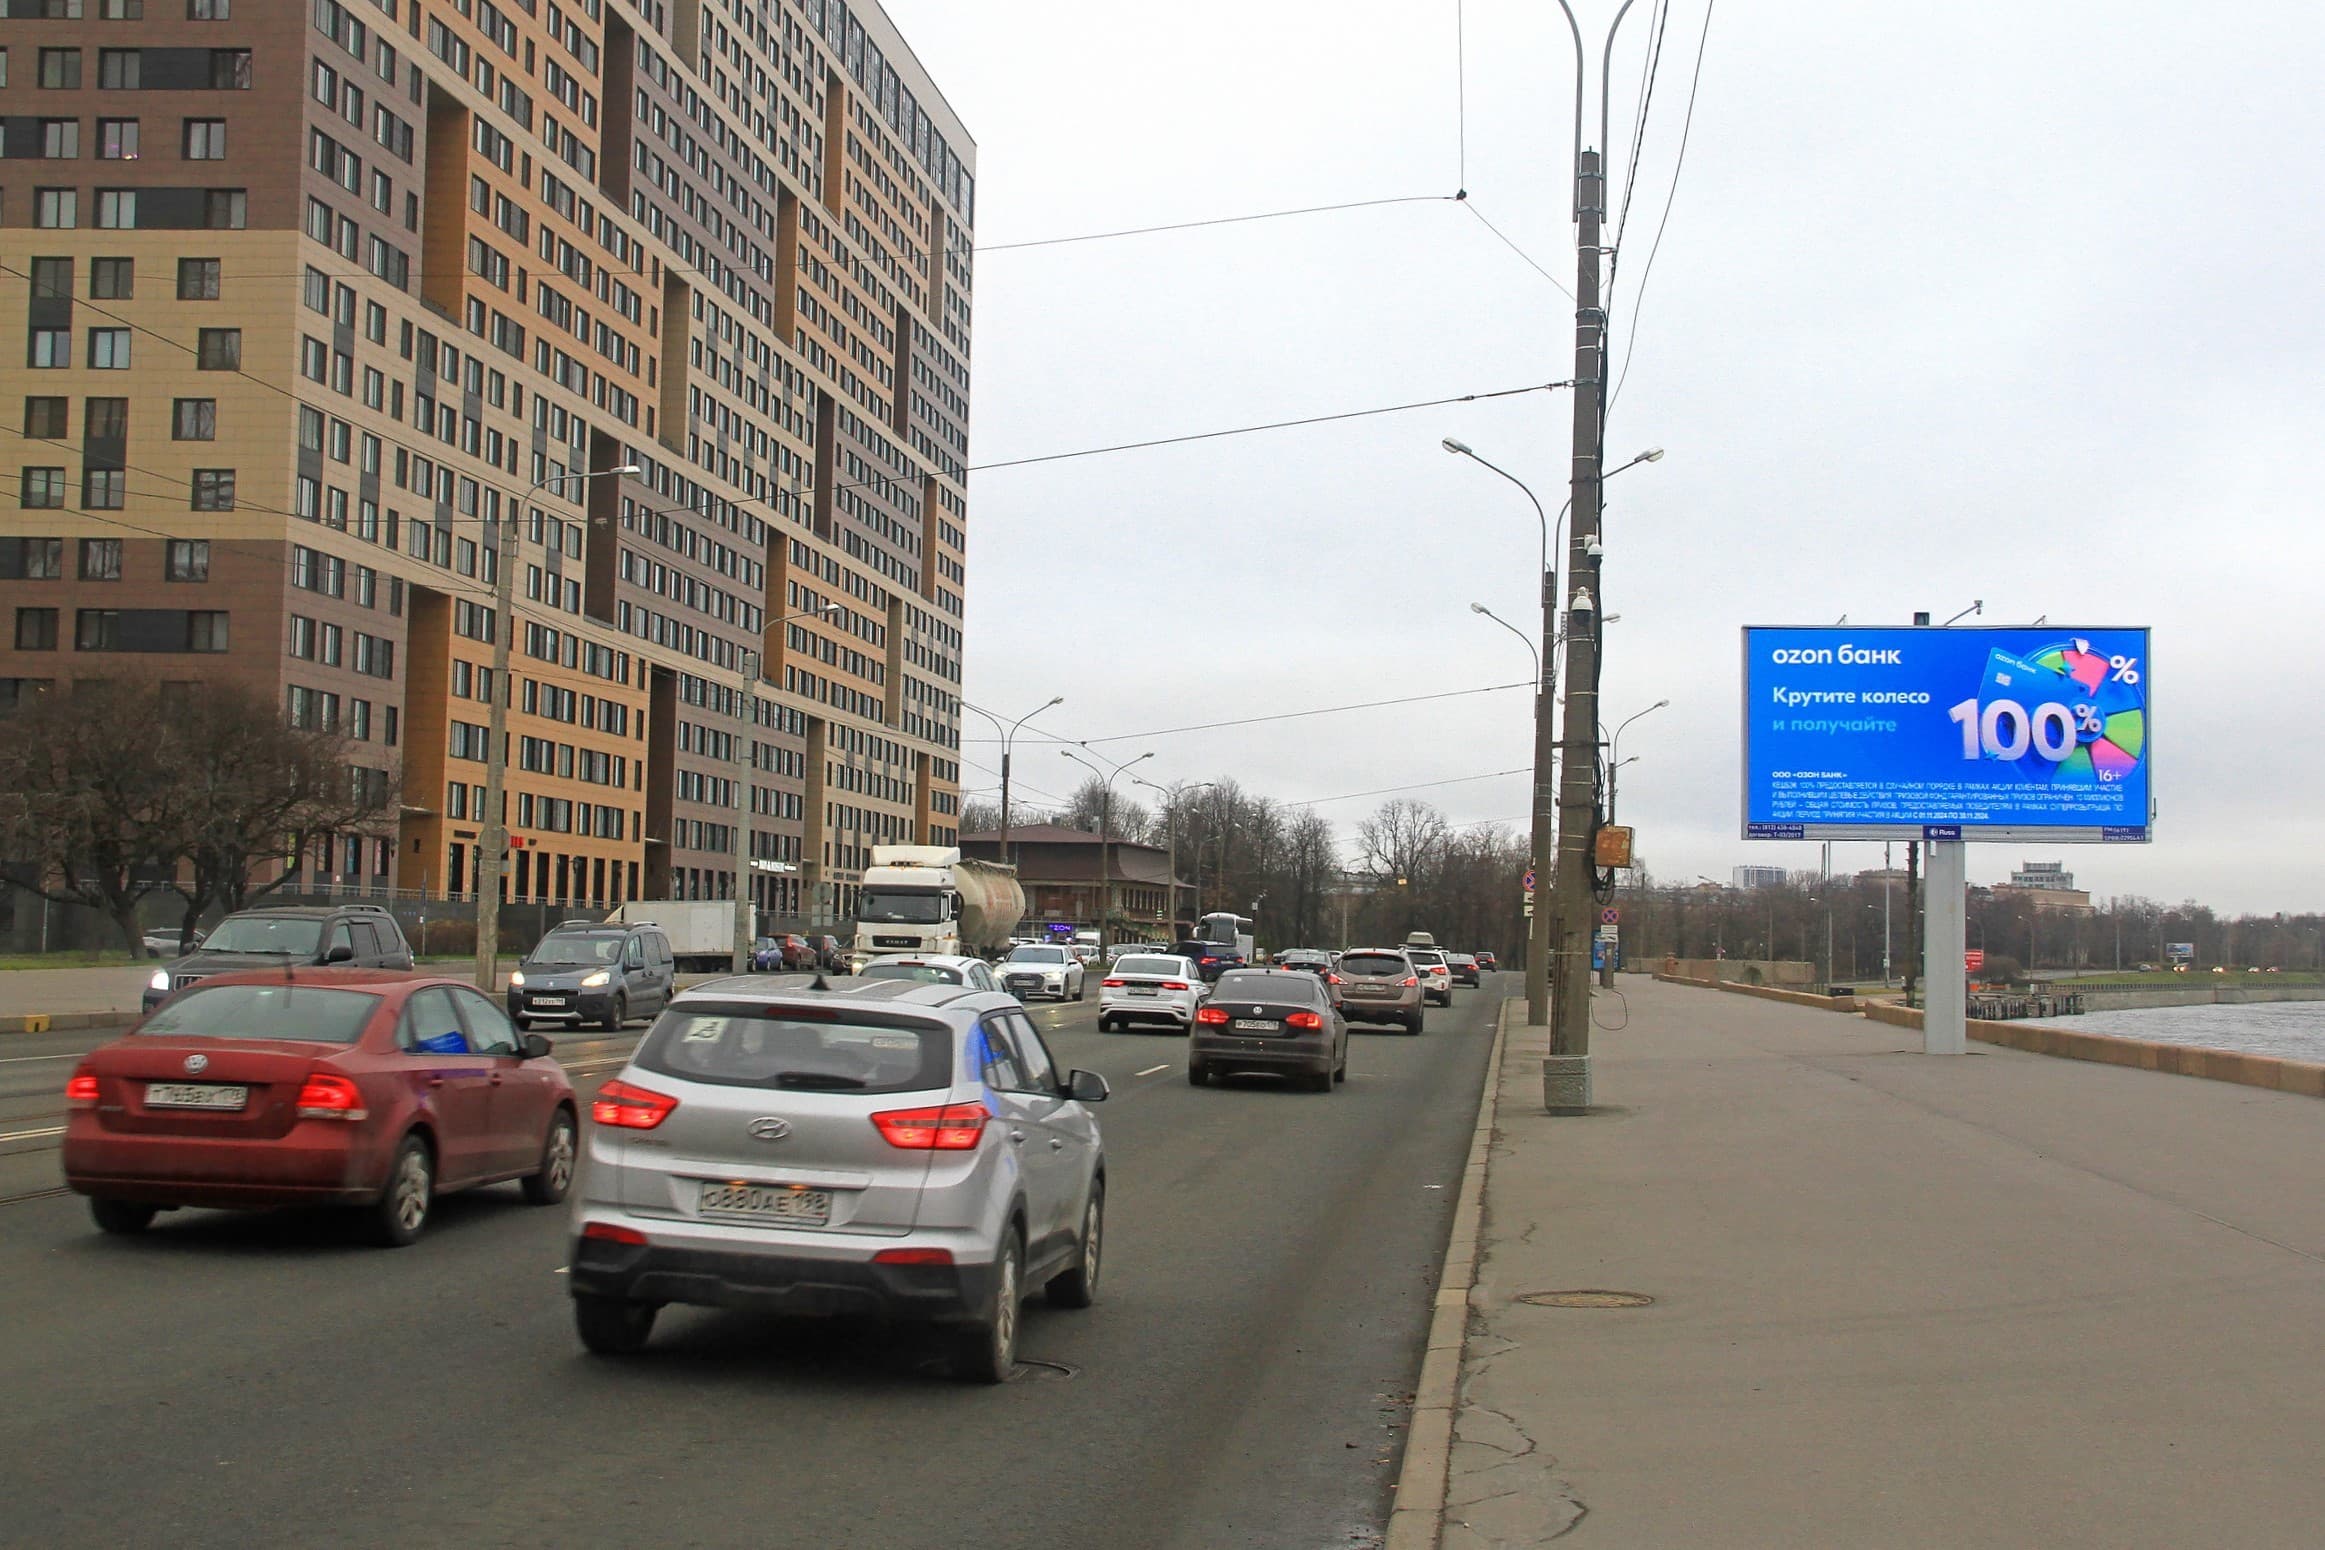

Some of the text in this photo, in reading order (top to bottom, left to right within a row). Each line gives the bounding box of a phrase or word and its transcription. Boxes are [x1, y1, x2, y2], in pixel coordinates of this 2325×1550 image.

[1772, 643, 1902, 664] ozon банк
[1772, 686, 1931, 707] Крутите колесо
[1772, 715, 1898, 736] и получайте
[1772, 771, 1792, 779] ООО
[2098, 769, 2122, 782] 16+
